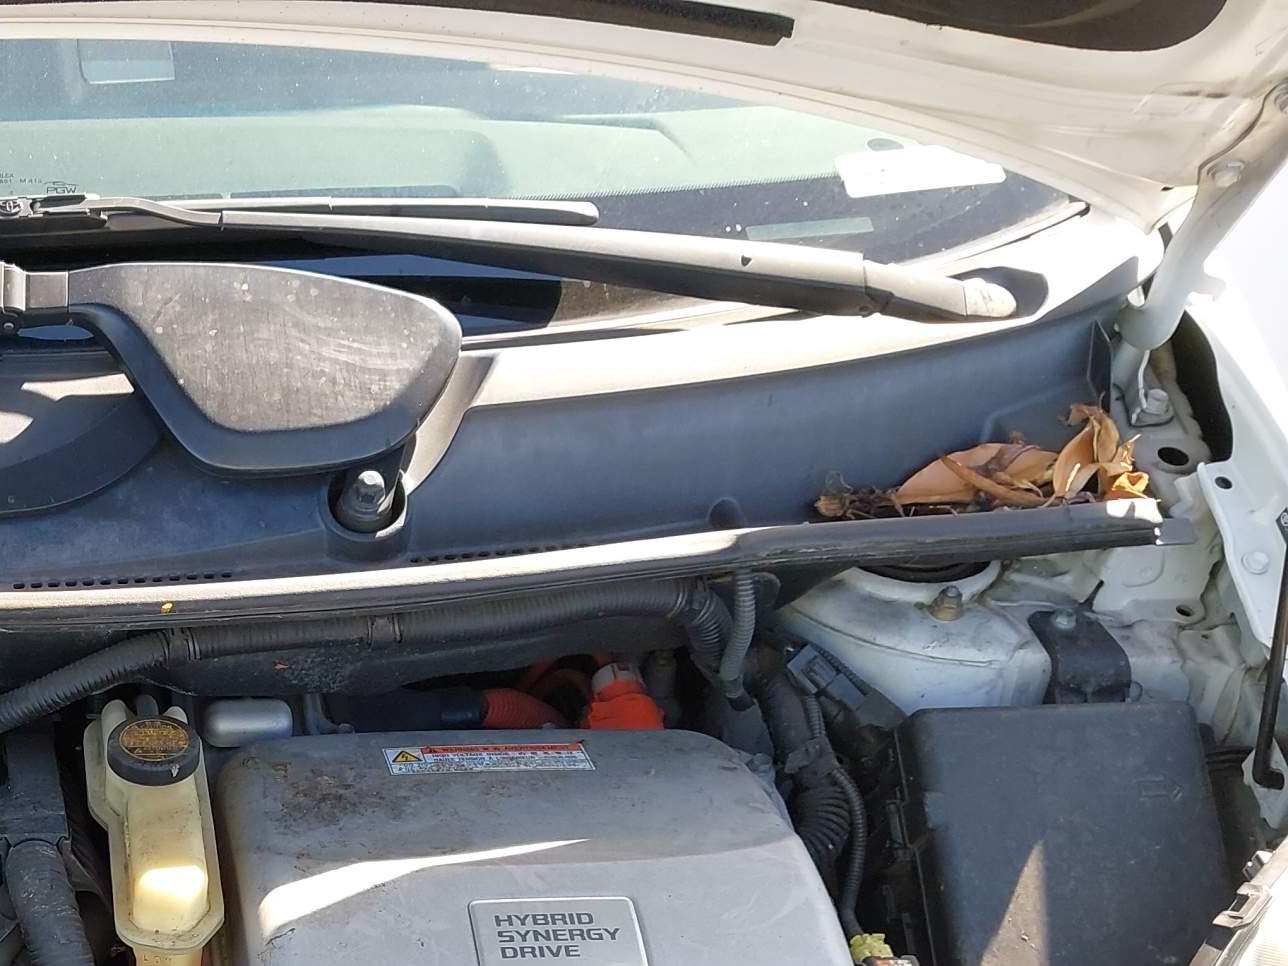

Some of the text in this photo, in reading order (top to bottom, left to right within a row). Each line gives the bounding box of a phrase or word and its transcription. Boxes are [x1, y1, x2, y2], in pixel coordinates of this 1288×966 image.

[46, 186, 77, 194] PGW
[494, 912, 594, 927] HYBRID
[497, 927, 621, 943] SYNERGY
[501, 944, 581, 959] DRIVE
